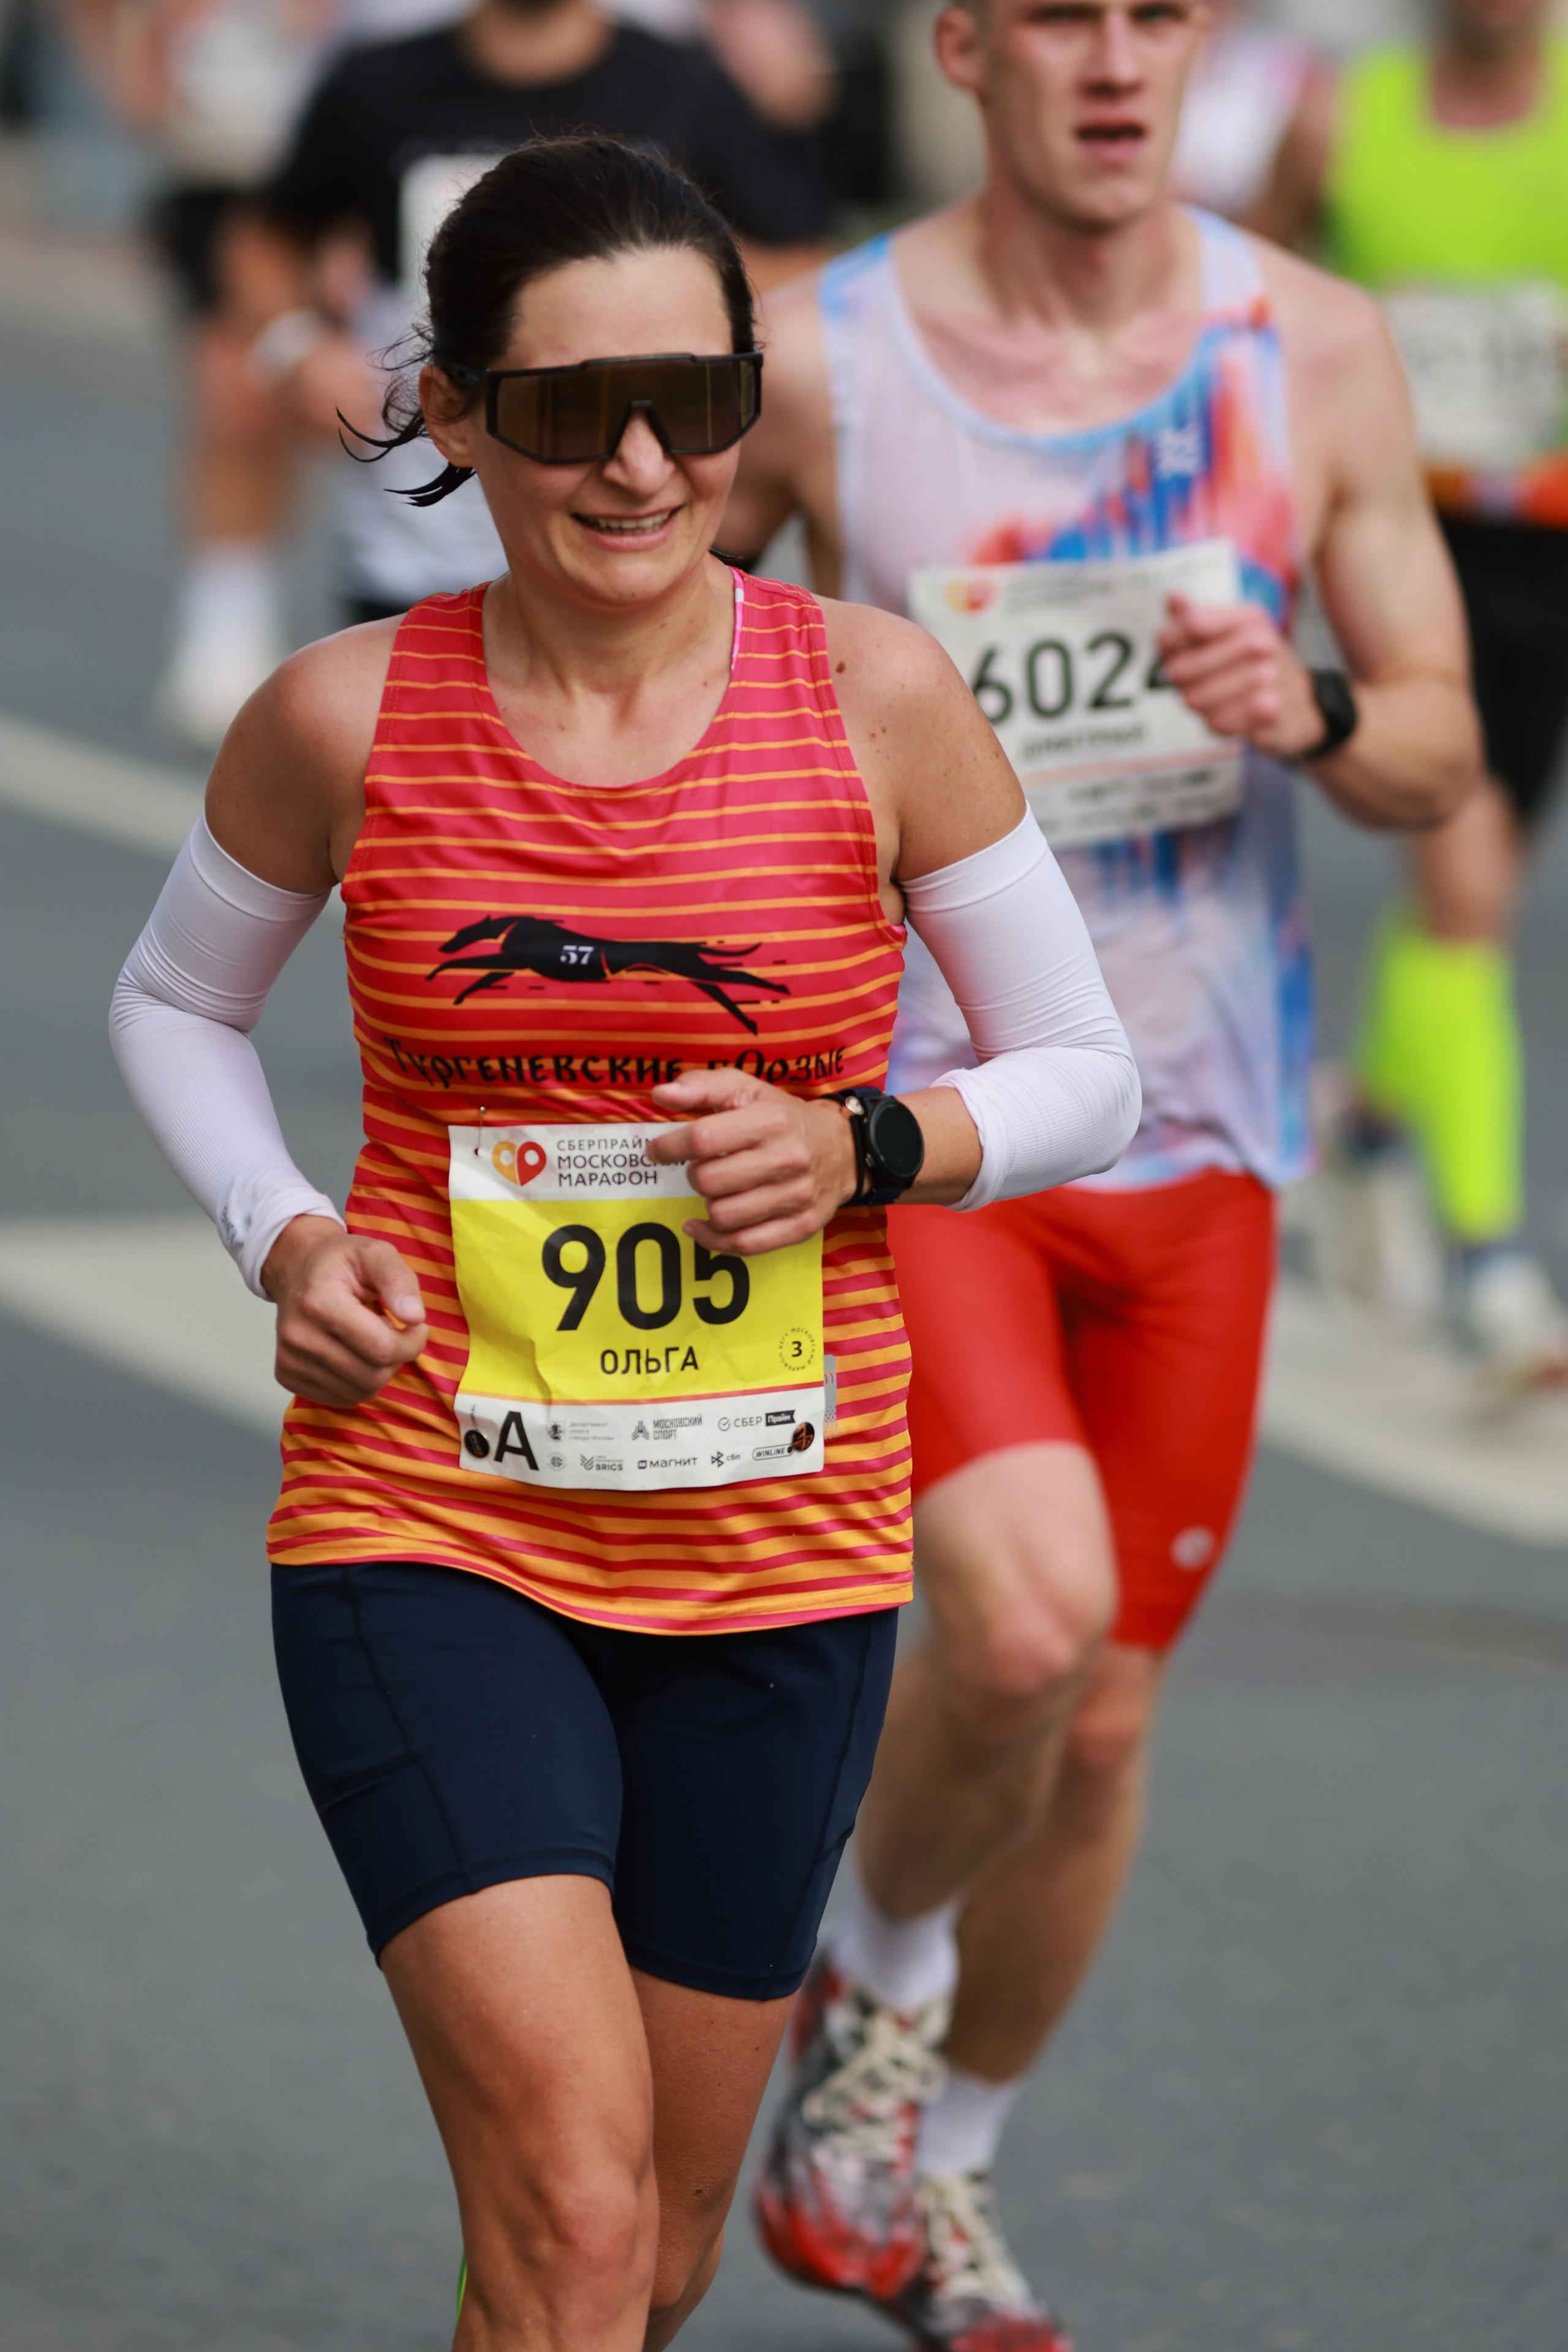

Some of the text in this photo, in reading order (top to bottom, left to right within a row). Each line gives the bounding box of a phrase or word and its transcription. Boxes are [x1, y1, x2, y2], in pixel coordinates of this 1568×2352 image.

[560, 945, 594, 965] 57
[557, 1136, 651, 1152] СБЕРПРАЙ
[559, 1170, 658, 1186] МАРАФОН
[542, 1222, 750, 1331] 905
[791, 1341, 802, 1357] 3
[600, 1346, 698, 1375] ОЛЬГА
[653, 1414, 703, 1429] МОСКОВСКИЙ
[734, 1413, 791, 1428] СБЕР Прайм
[653, 1430, 677, 1440] СПОРТ
[755, 1447, 785, 1458] WINLINE
[649, 1457, 698, 1469] магнит
